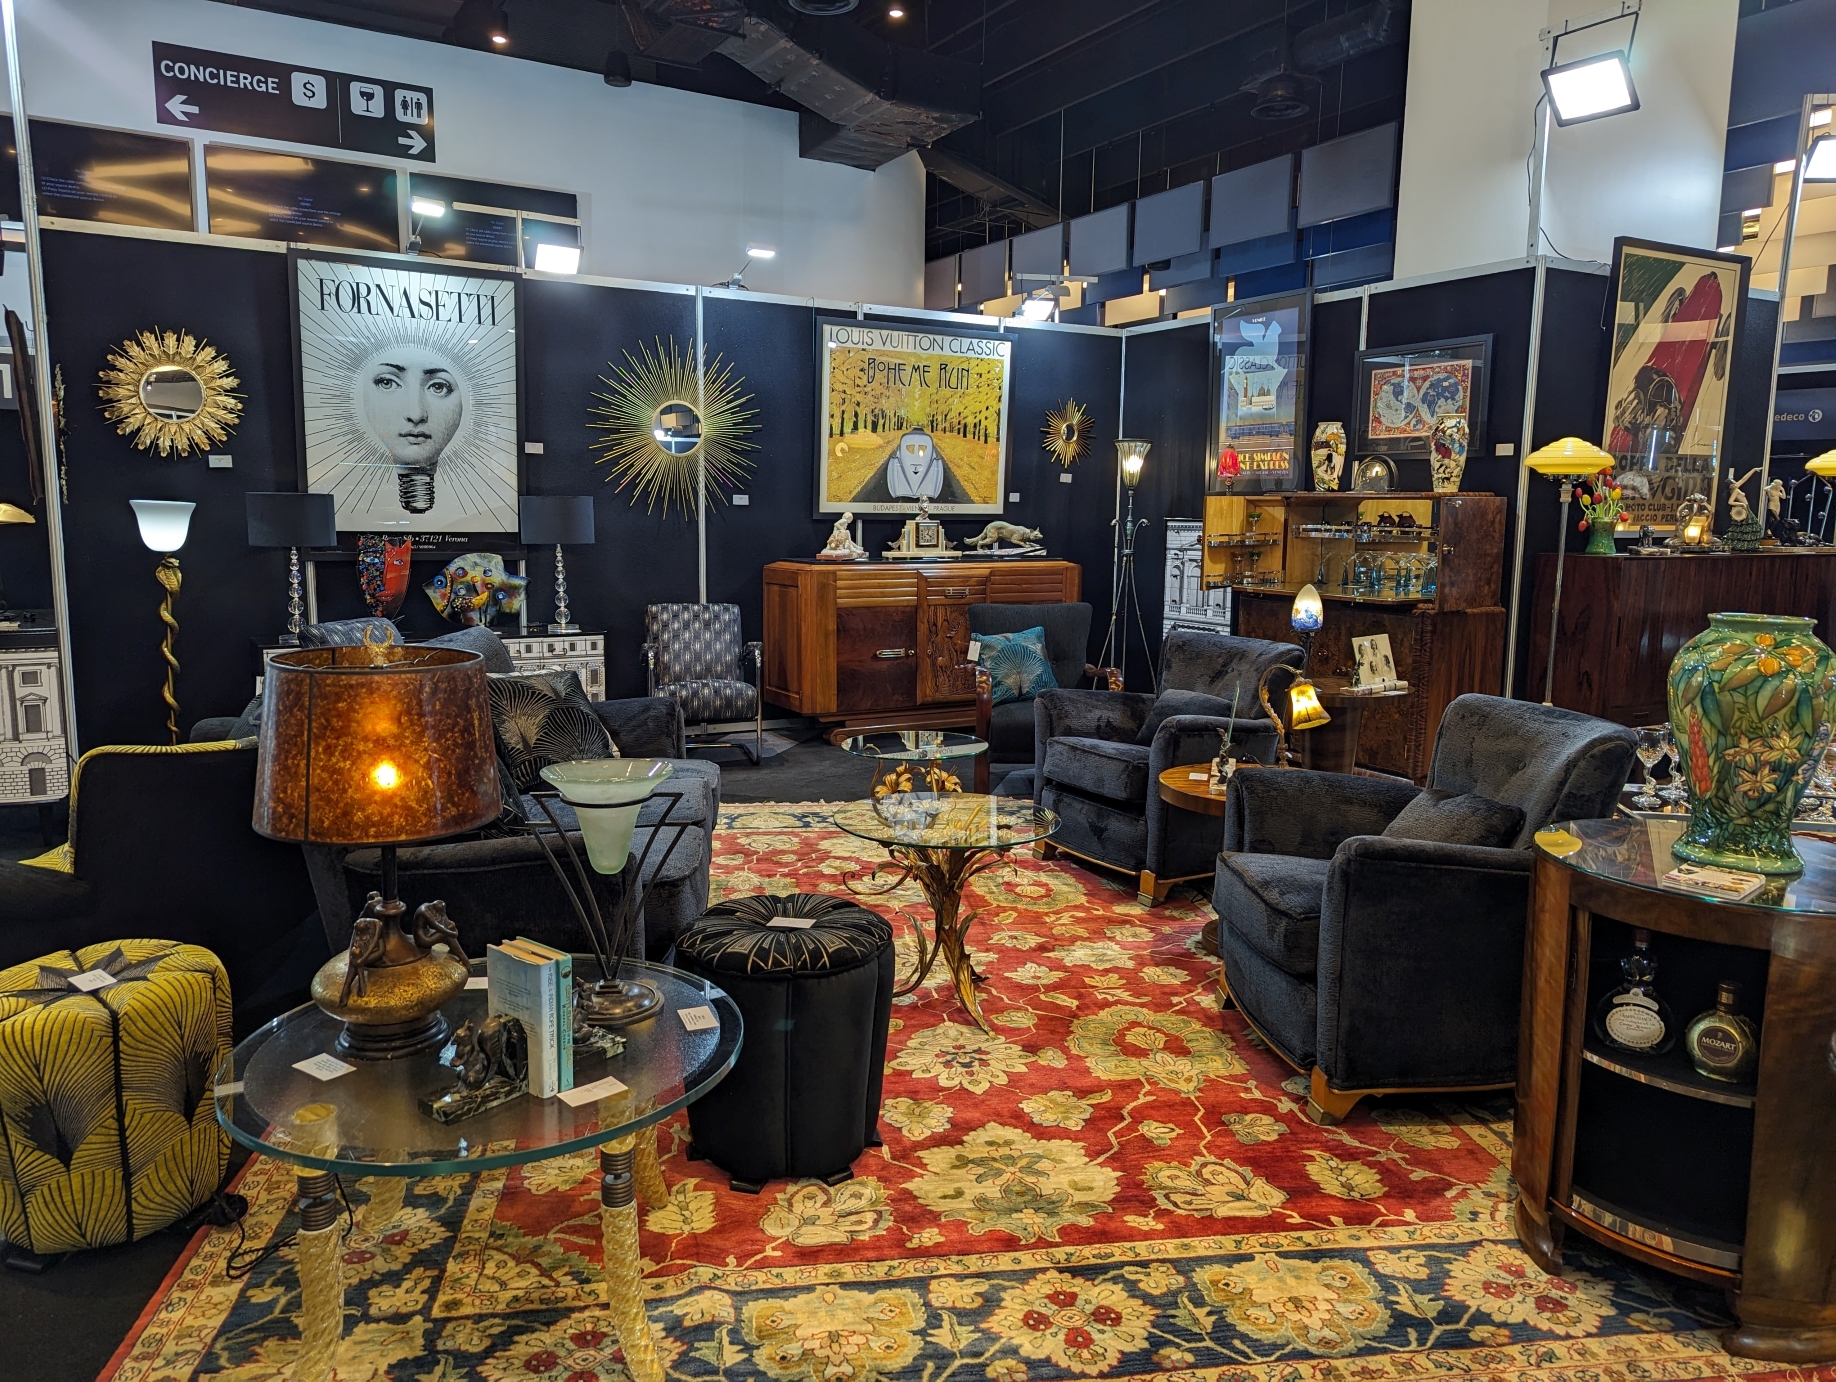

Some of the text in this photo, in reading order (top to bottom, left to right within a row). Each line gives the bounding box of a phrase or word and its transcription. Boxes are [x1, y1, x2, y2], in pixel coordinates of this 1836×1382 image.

[159, 59, 280, 94] CONCIERGE
[316, 277, 498, 326] FORNASETTI
[829, 327, 1006, 358] LOUIS VUITTON CLASSIC
[938, 363, 970, 391] RUN
[1239, 451, 1290, 462] ICE SIMPLON
[1240, 460, 1290, 470] NT-EXPRESS
[1664, 456, 1710, 474] DELLA
[872, 504, 902, 512] BUDAPEST
[419, 534, 442, 543] 37121
[445, 534, 469, 543] Verona
[547, 972, 555, 987] RISE
[1701, 1036, 1737, 1051] MOZART
